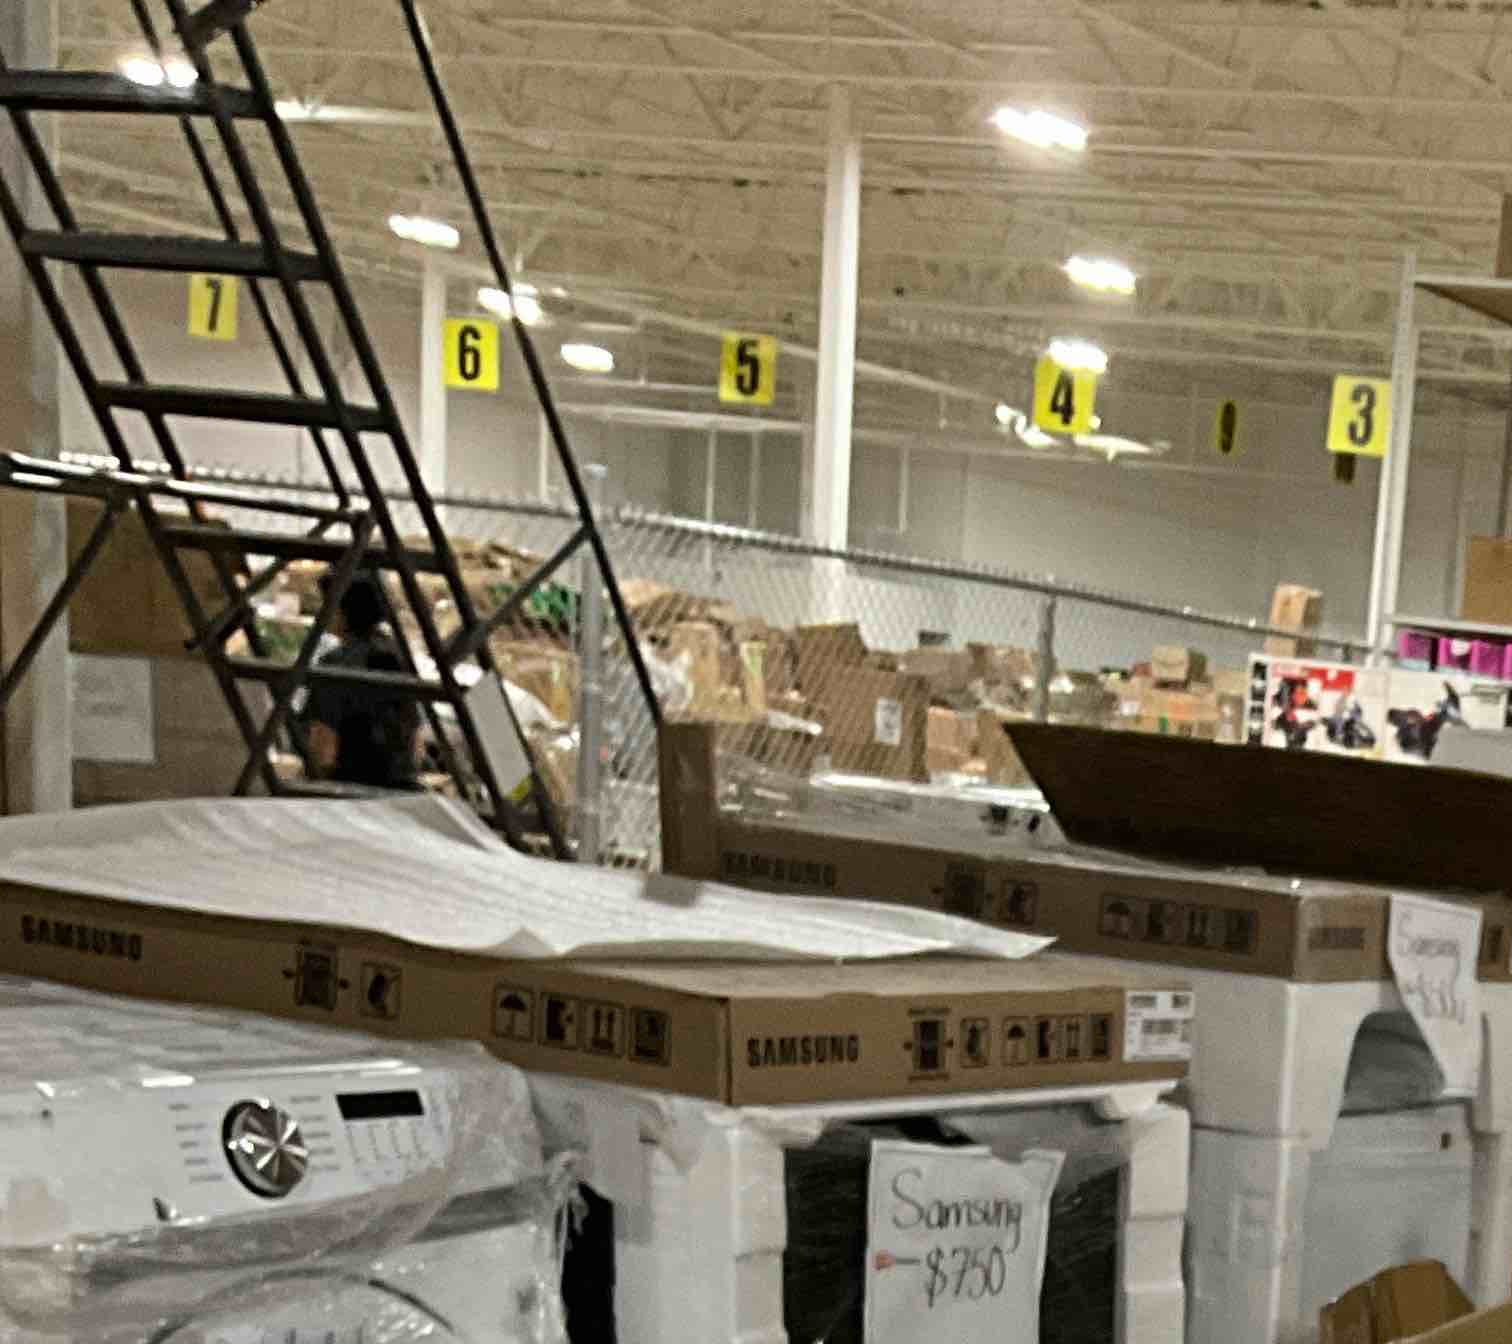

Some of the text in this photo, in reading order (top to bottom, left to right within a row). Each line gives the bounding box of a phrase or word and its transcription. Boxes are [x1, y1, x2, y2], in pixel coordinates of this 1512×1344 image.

[206, 278, 222, 332] 7
[457, 331, 483, 380] 6
[734, 349, 761, 394] 5
[1048, 371, 1076, 424] 4
[1348, 385, 1375, 446] 3
[21, 914, 143, 961] SAMSUNG
[747, 1033, 860, 1067] SAMSUNG
[892, 1167, 1023, 1254] Samsung
[925, 1245, 1007, 1309] $750
